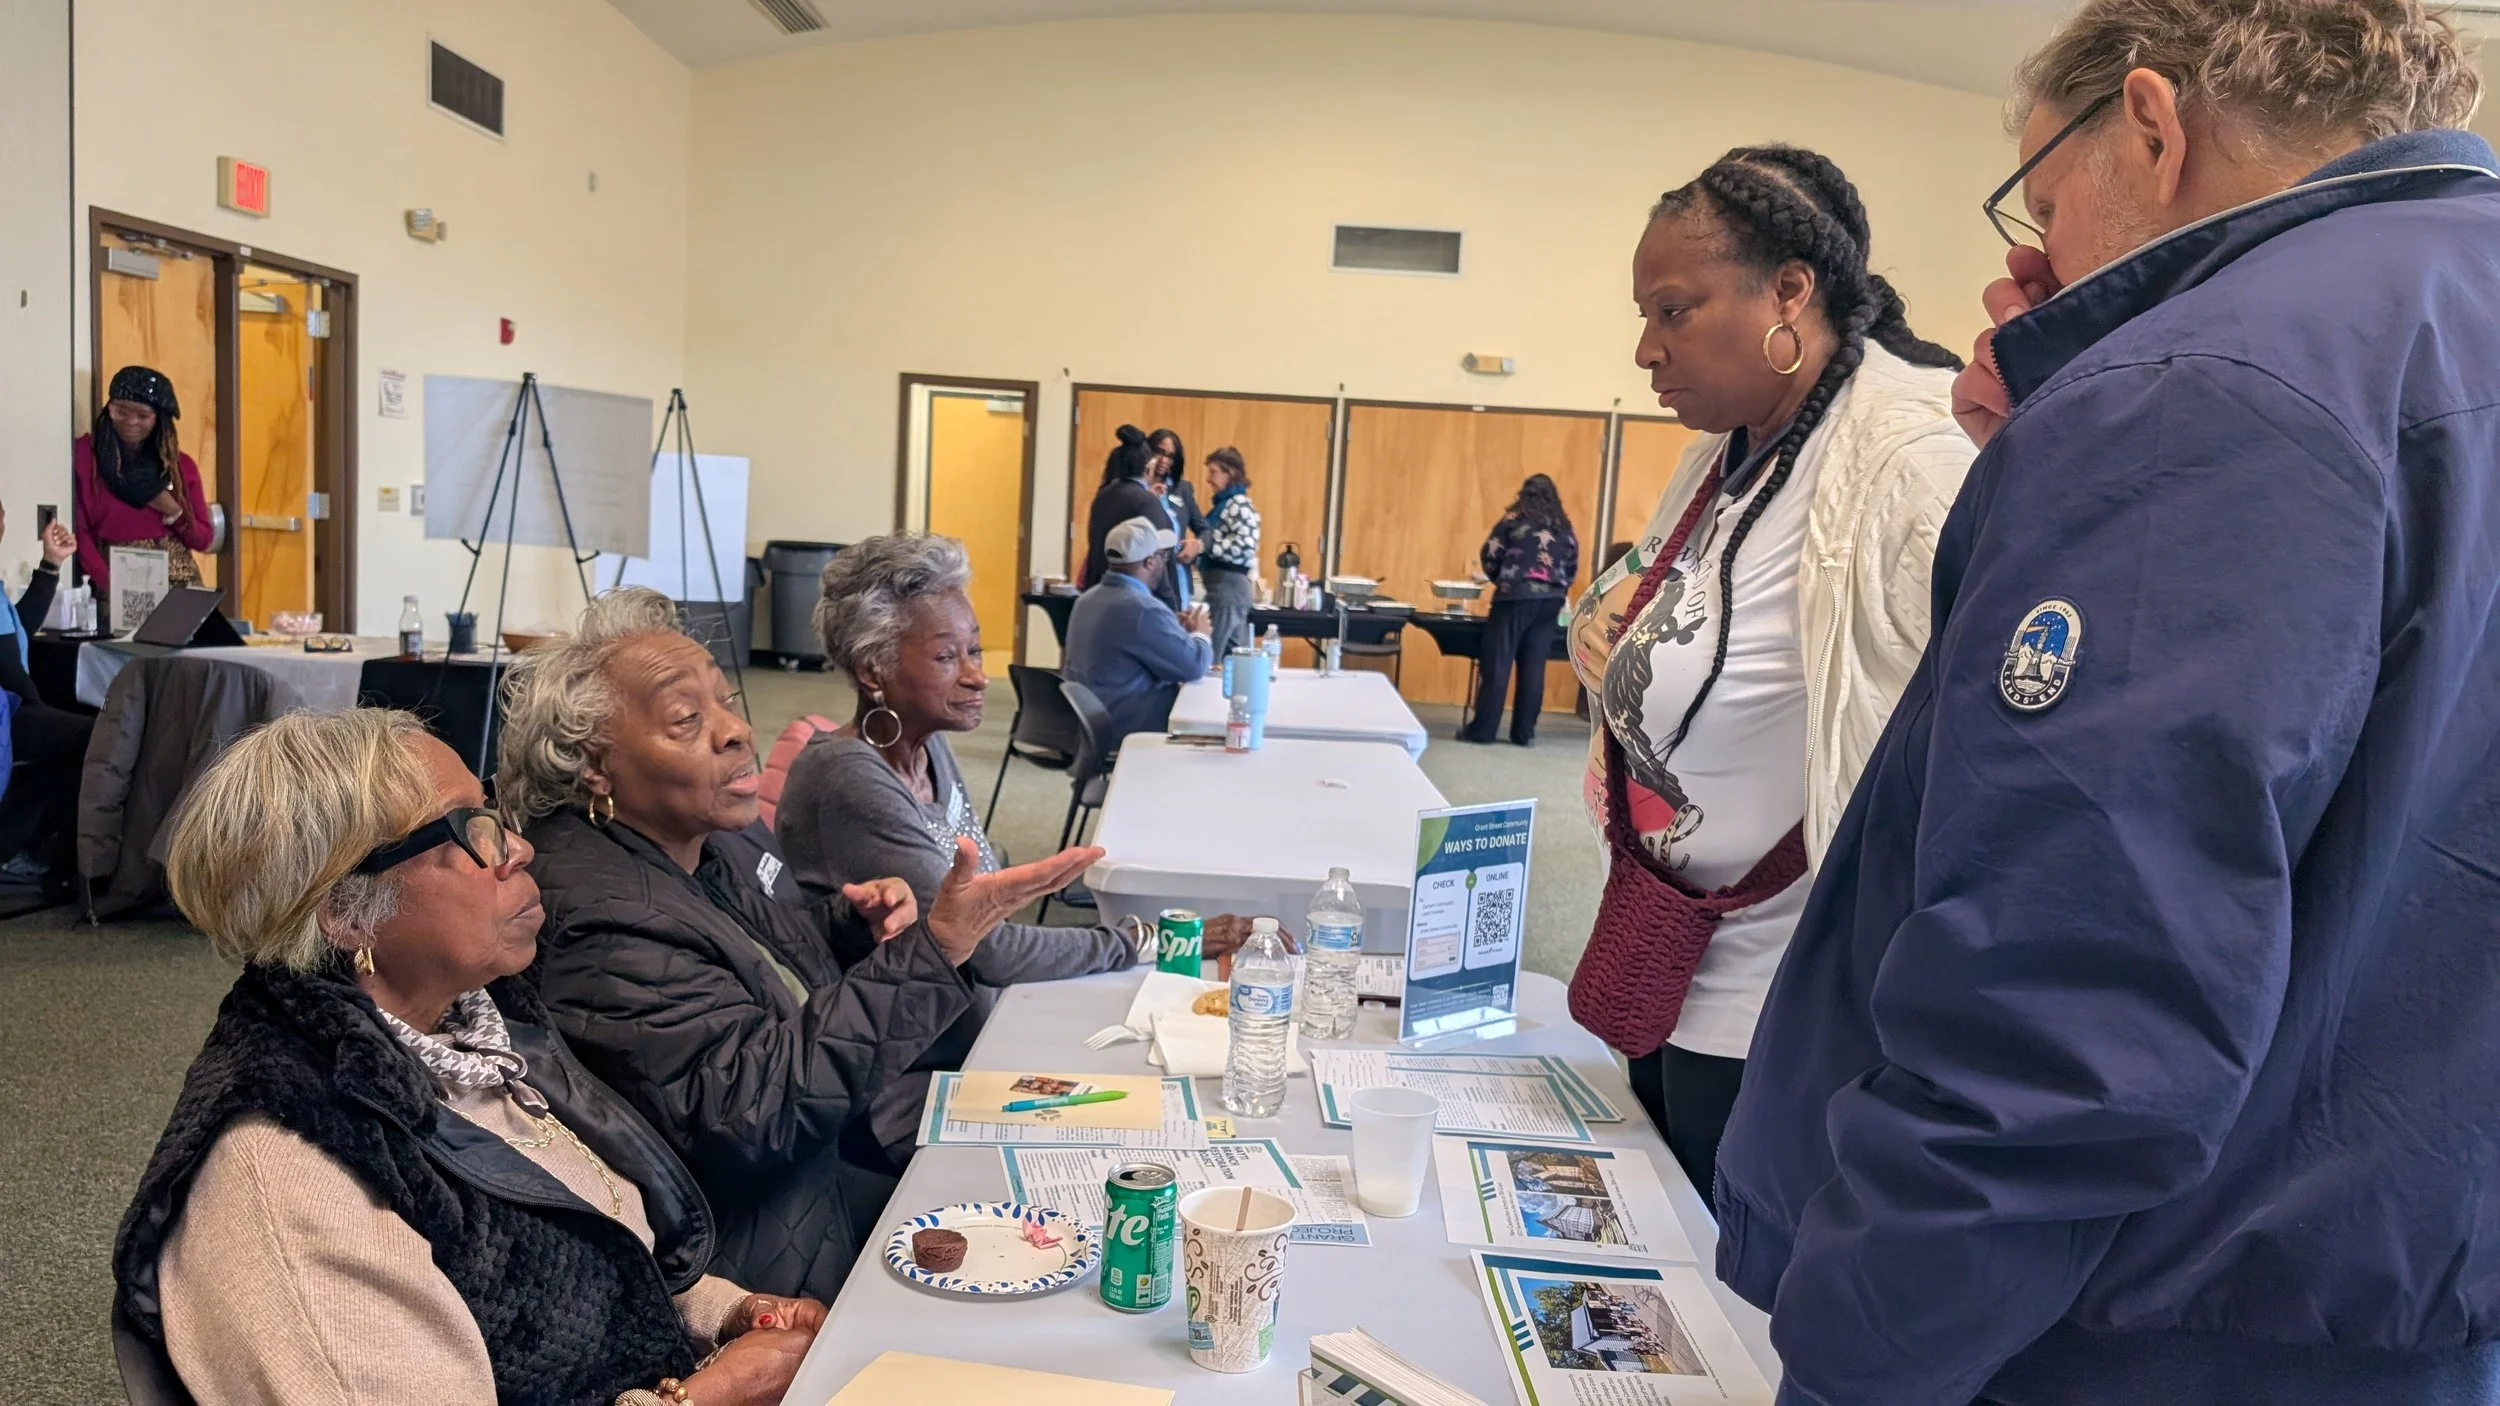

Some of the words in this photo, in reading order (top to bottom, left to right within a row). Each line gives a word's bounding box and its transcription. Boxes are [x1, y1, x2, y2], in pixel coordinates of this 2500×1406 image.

[1685, 590, 1706, 618] OF
[2036, 604, 2058, 614] SINCE
[2004, 671, 2034, 705] LANDS'
[2039, 679, 2062, 702] END
[1475, 823, 1488, 832] Grant
[1489, 822, 1503, 830] Street
[1503, 819, 1529, 829] Community
[1445, 839, 1473, 854] WAYS
[1475, 838, 1488, 850] TO
[1489, 832, 1528, 849] DONATE
[1433, 879, 1455, 890] CHECK
[1486, 871, 1509, 882] ONLINE
[1200, 1150, 1216, 1167] OJECT
[1210, 1146, 1236, 1180] RESTORATION
[1220, 1146, 1240, 1166] BRANCH
[1301, 1234, 1355, 1242] GRANT
